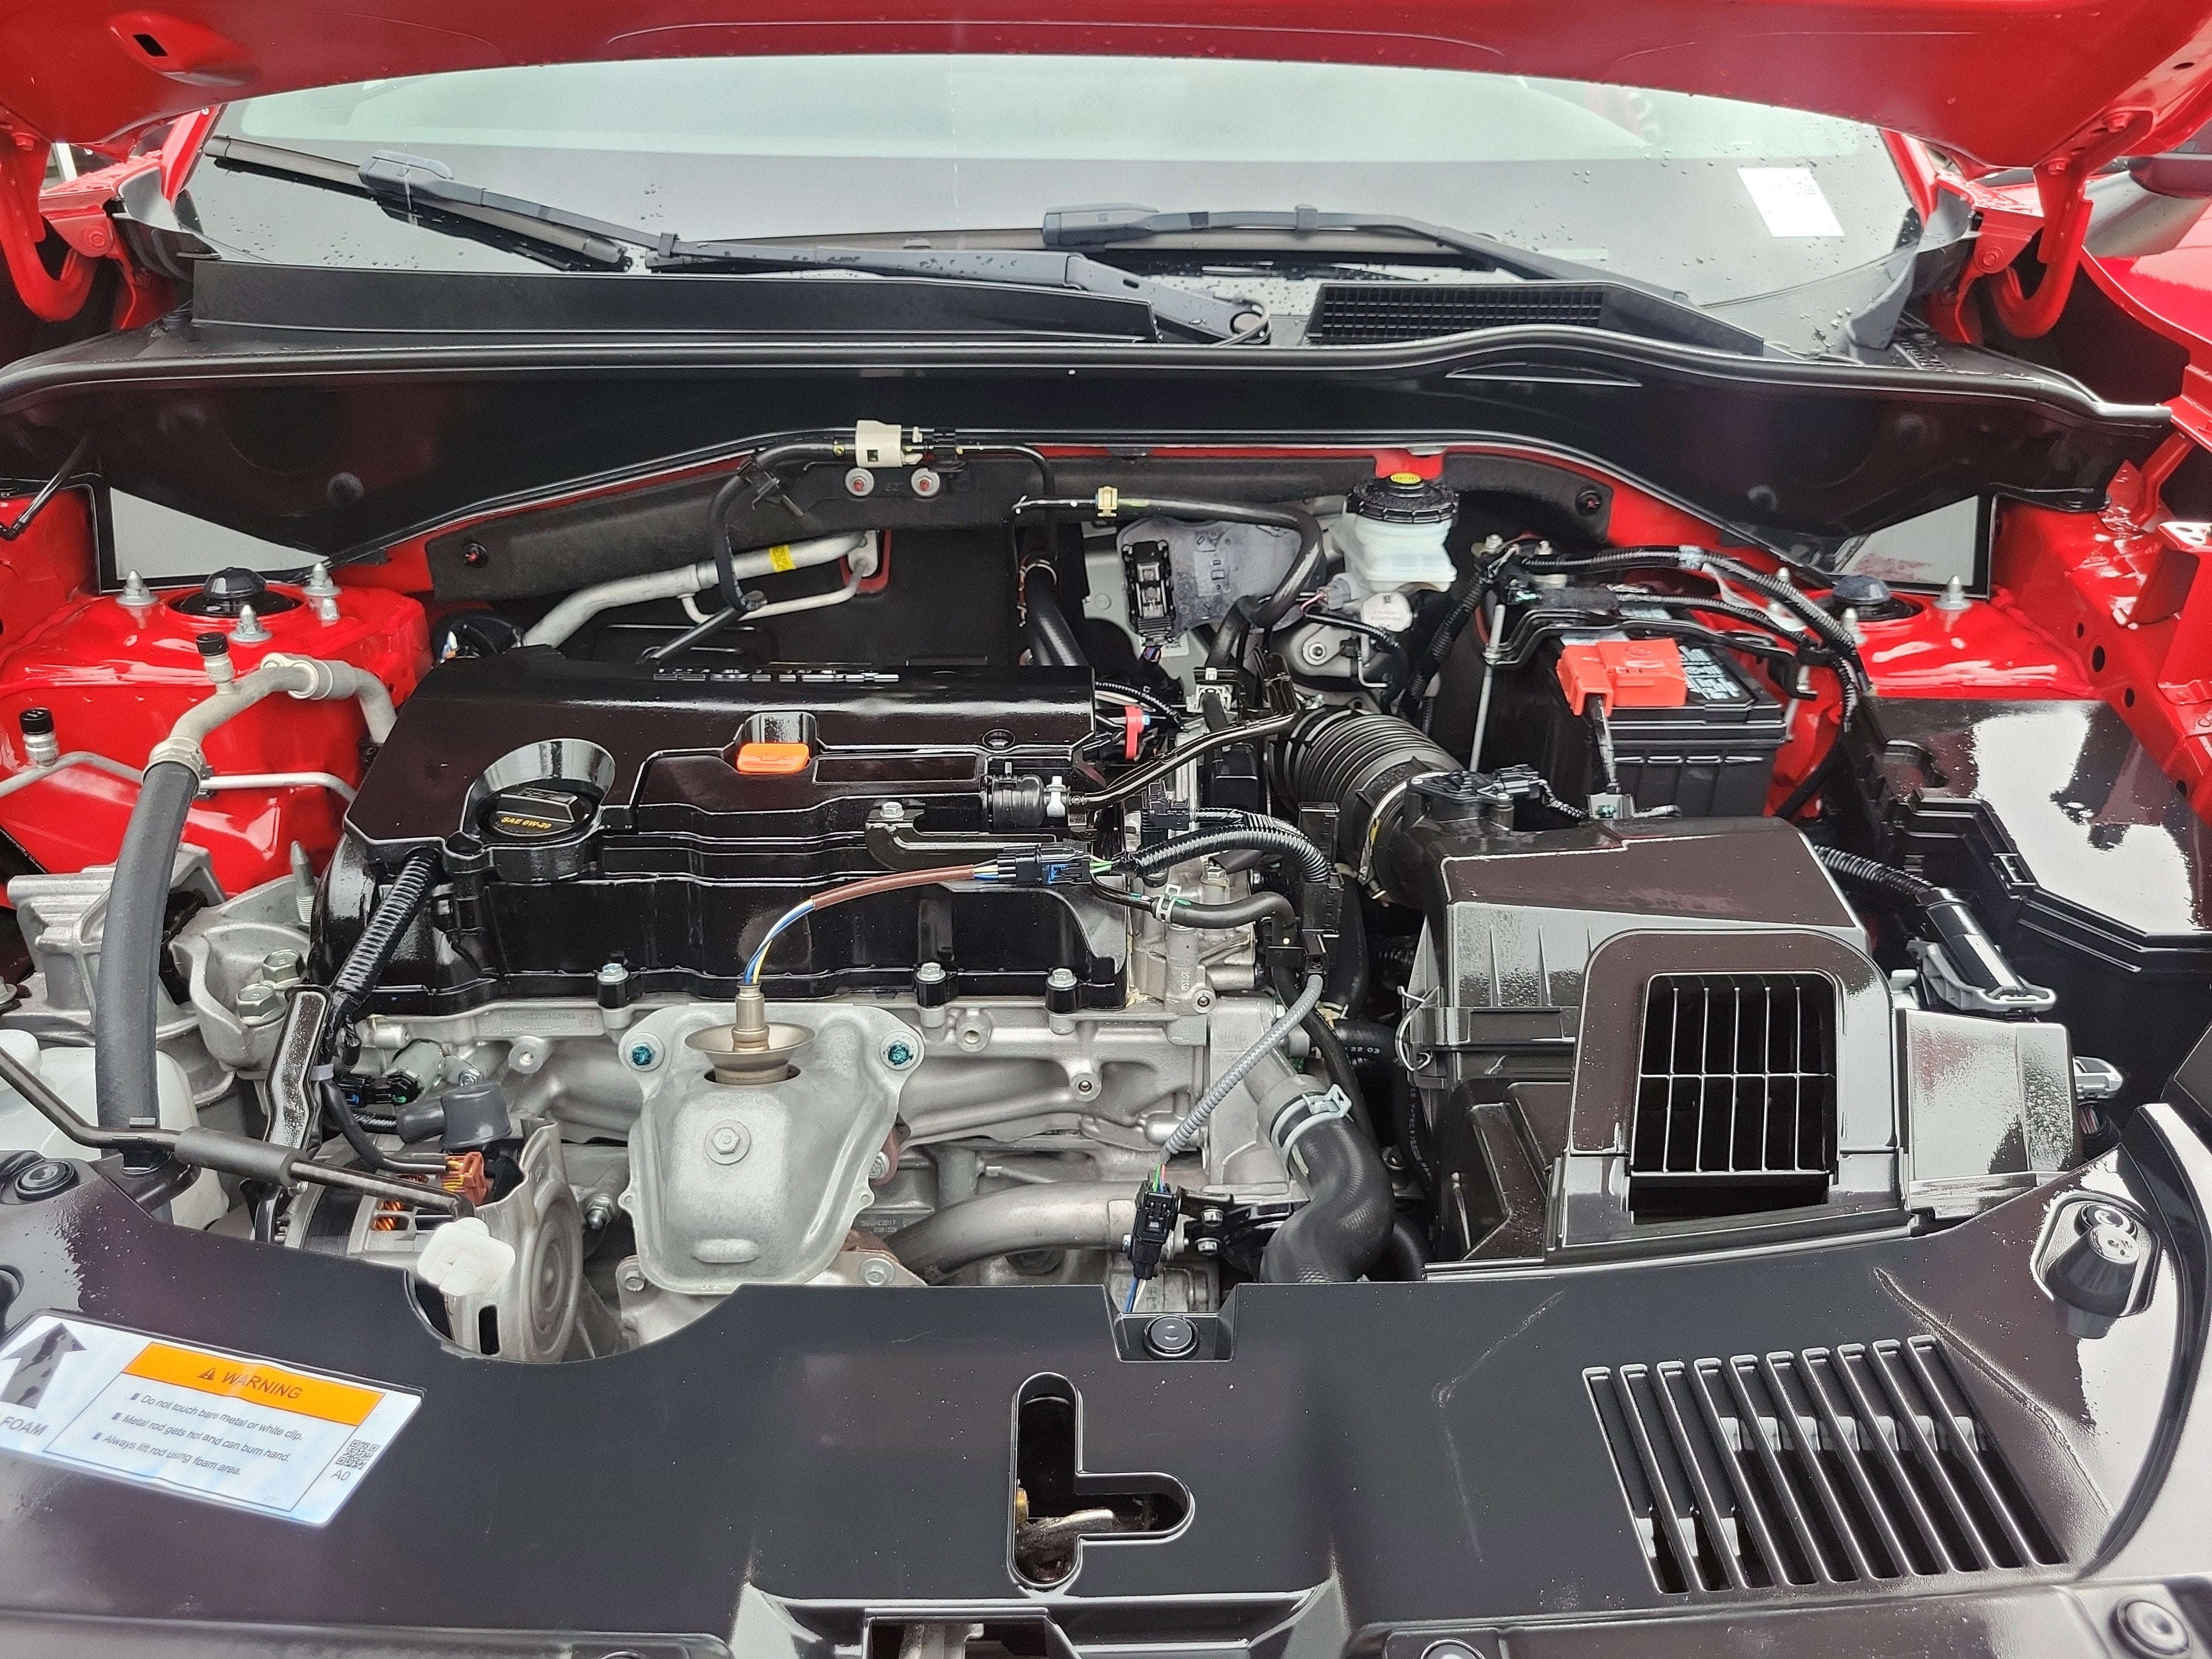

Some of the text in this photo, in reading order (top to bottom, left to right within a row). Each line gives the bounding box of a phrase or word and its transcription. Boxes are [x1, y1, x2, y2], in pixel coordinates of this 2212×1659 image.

[500, 816, 552, 829] SAE 0W-20
[221, 1371, 303, 1399] WARNING
[0, 1415, 49, 1436] FOAM
[141, 1395, 156, 1404] Do
[155, 1400, 174, 1409] not
[172, 1402, 198, 1415] touch
[198, 1408, 219, 1419] bare
[219, 1414, 249, 1427] metal
[259, 1424, 284, 1436] white
[284, 1430, 302, 1441] clip.
[101, 1434, 241, 1475] Always lift rod using foam area.
[122, 1414, 151, 1427] Metal
[149, 1423, 168, 1431] rod
[163, 1426, 187, 1437] gets
[202, 1433, 224, 1445] and
[222, 1440, 241, 1450] can
[240, 1443, 264, 1455] burn
[263, 1448, 292, 1463] hand.
